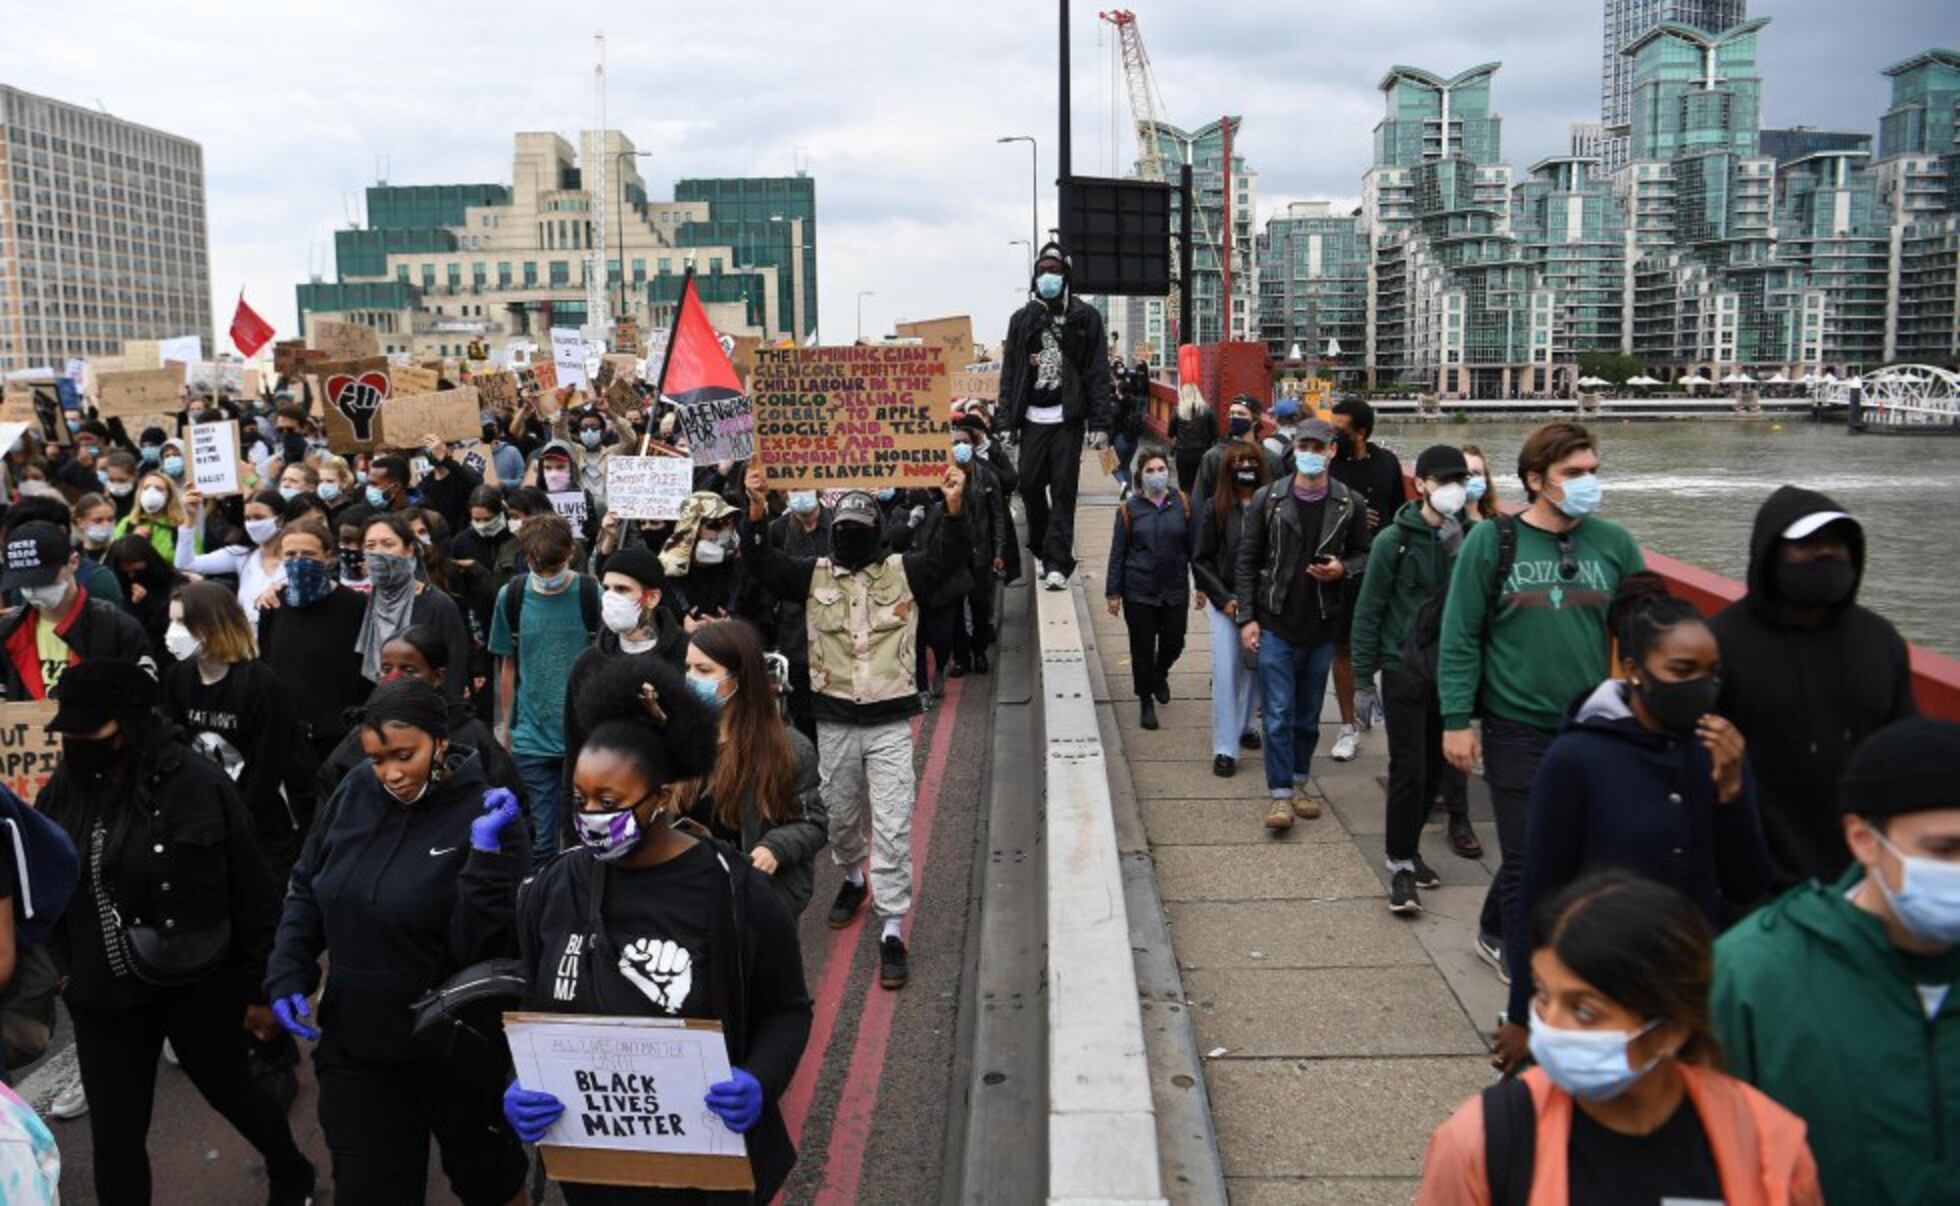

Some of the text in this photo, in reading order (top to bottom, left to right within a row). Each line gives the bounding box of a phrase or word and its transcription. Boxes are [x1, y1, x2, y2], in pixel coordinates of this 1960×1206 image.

[754, 349, 791, 362] THE
[818, 347, 881, 362] MINING
[883, 347, 943, 362] GIANT
[754, 362, 946, 378] GLENCORE PROFIT FROM
[753, 378, 797, 392] CHILD
[800, 378, 867, 392] LABOUR
[892, 377, 932, 392] THE
[755, 392, 914, 408] CONGO SELLING
[846, 408, 870, 421] TO
[875, 407, 931, 421] APPLE
[757, 422, 830, 436] GOOGLE
[834, 421, 882, 435] AND
[889, 421, 952, 435] TESLA
[759, 436, 839, 451] EXPOSE
[845, 435, 895, 449] AND
[761, 449, 947, 465] DISMANTLE MODERN
[766, 464, 950, 478] DAY SLAVERY NOW
[1503, 560, 1609, 595] ARIZONA
[575, 1070, 657, 1094] BLACK
[584, 1094, 660, 1115] LIVES
[581, 1113, 686, 1137] MATTER
